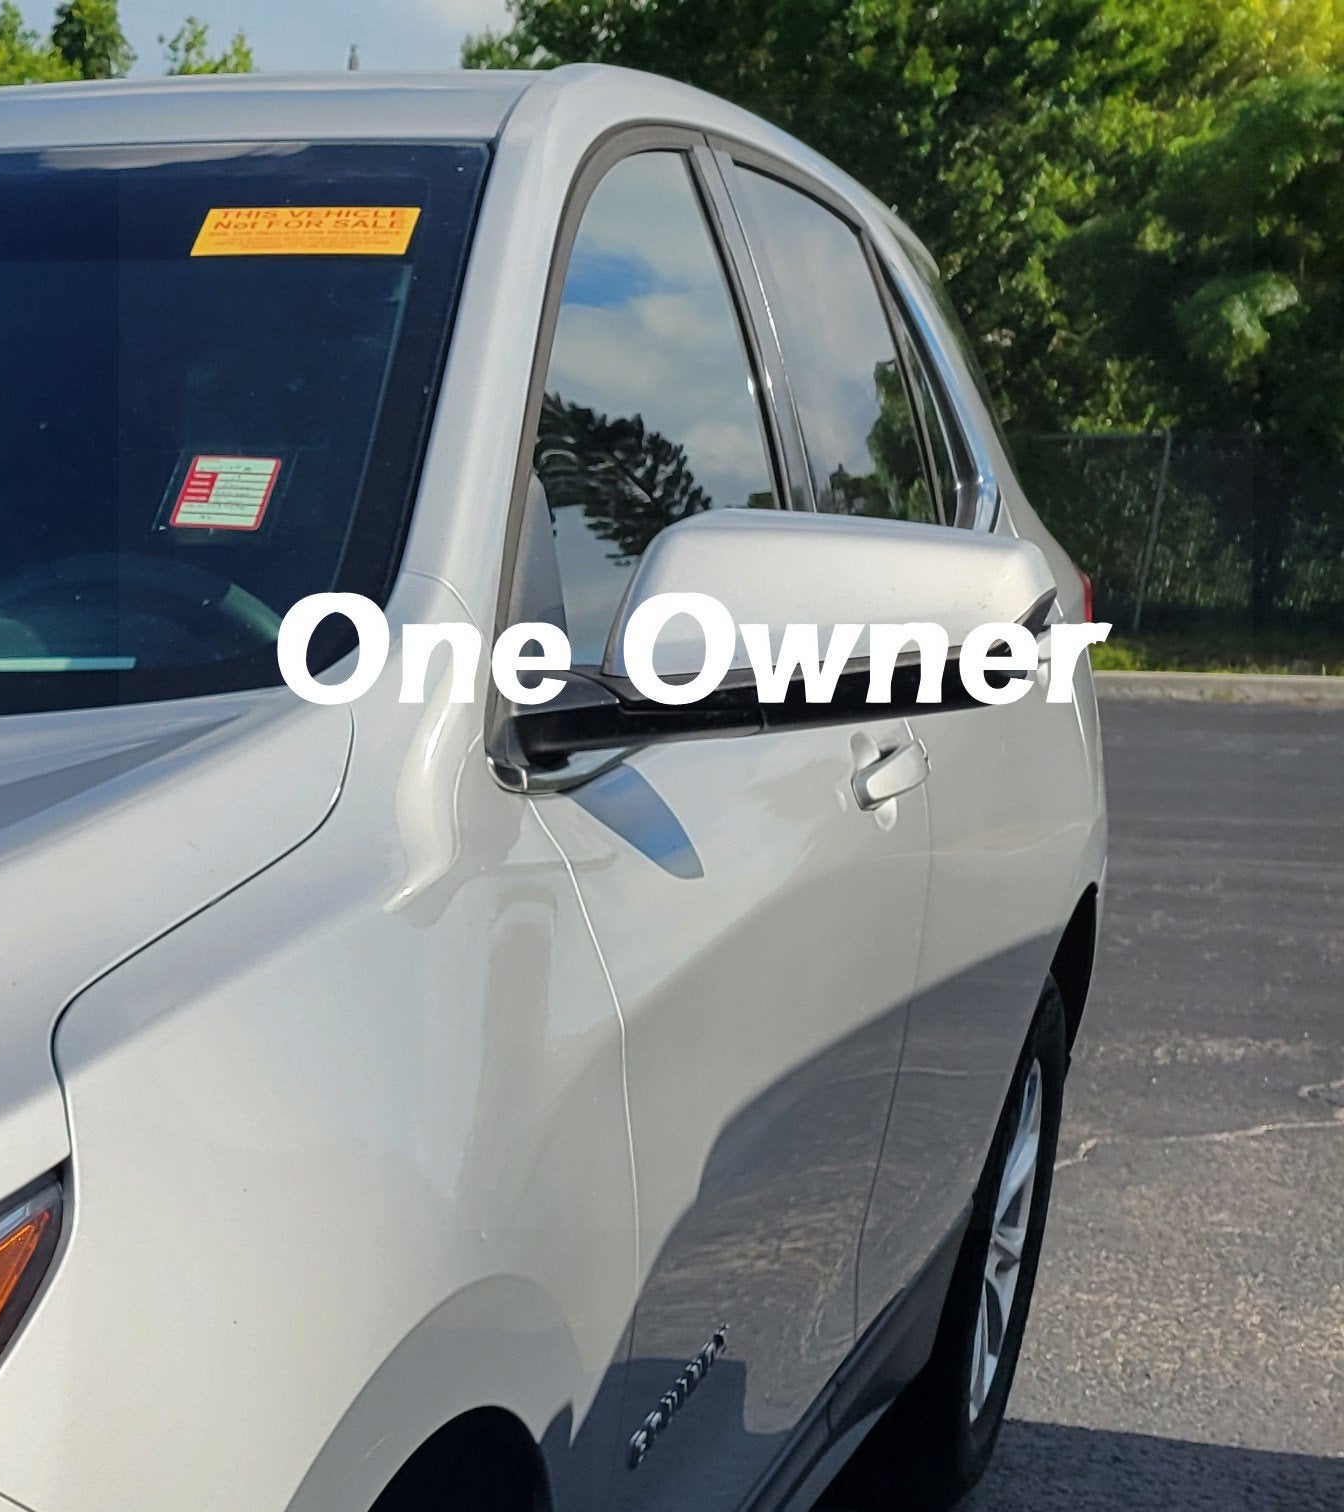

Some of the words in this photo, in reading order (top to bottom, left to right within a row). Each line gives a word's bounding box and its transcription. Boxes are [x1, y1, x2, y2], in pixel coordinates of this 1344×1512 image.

[221, 210, 278, 220] THIS
[289, 209, 406, 219] VEHICLE
[213, 220, 257, 230] Not
[267, 219, 324, 229] FOR
[331, 218, 405, 229] SALE
